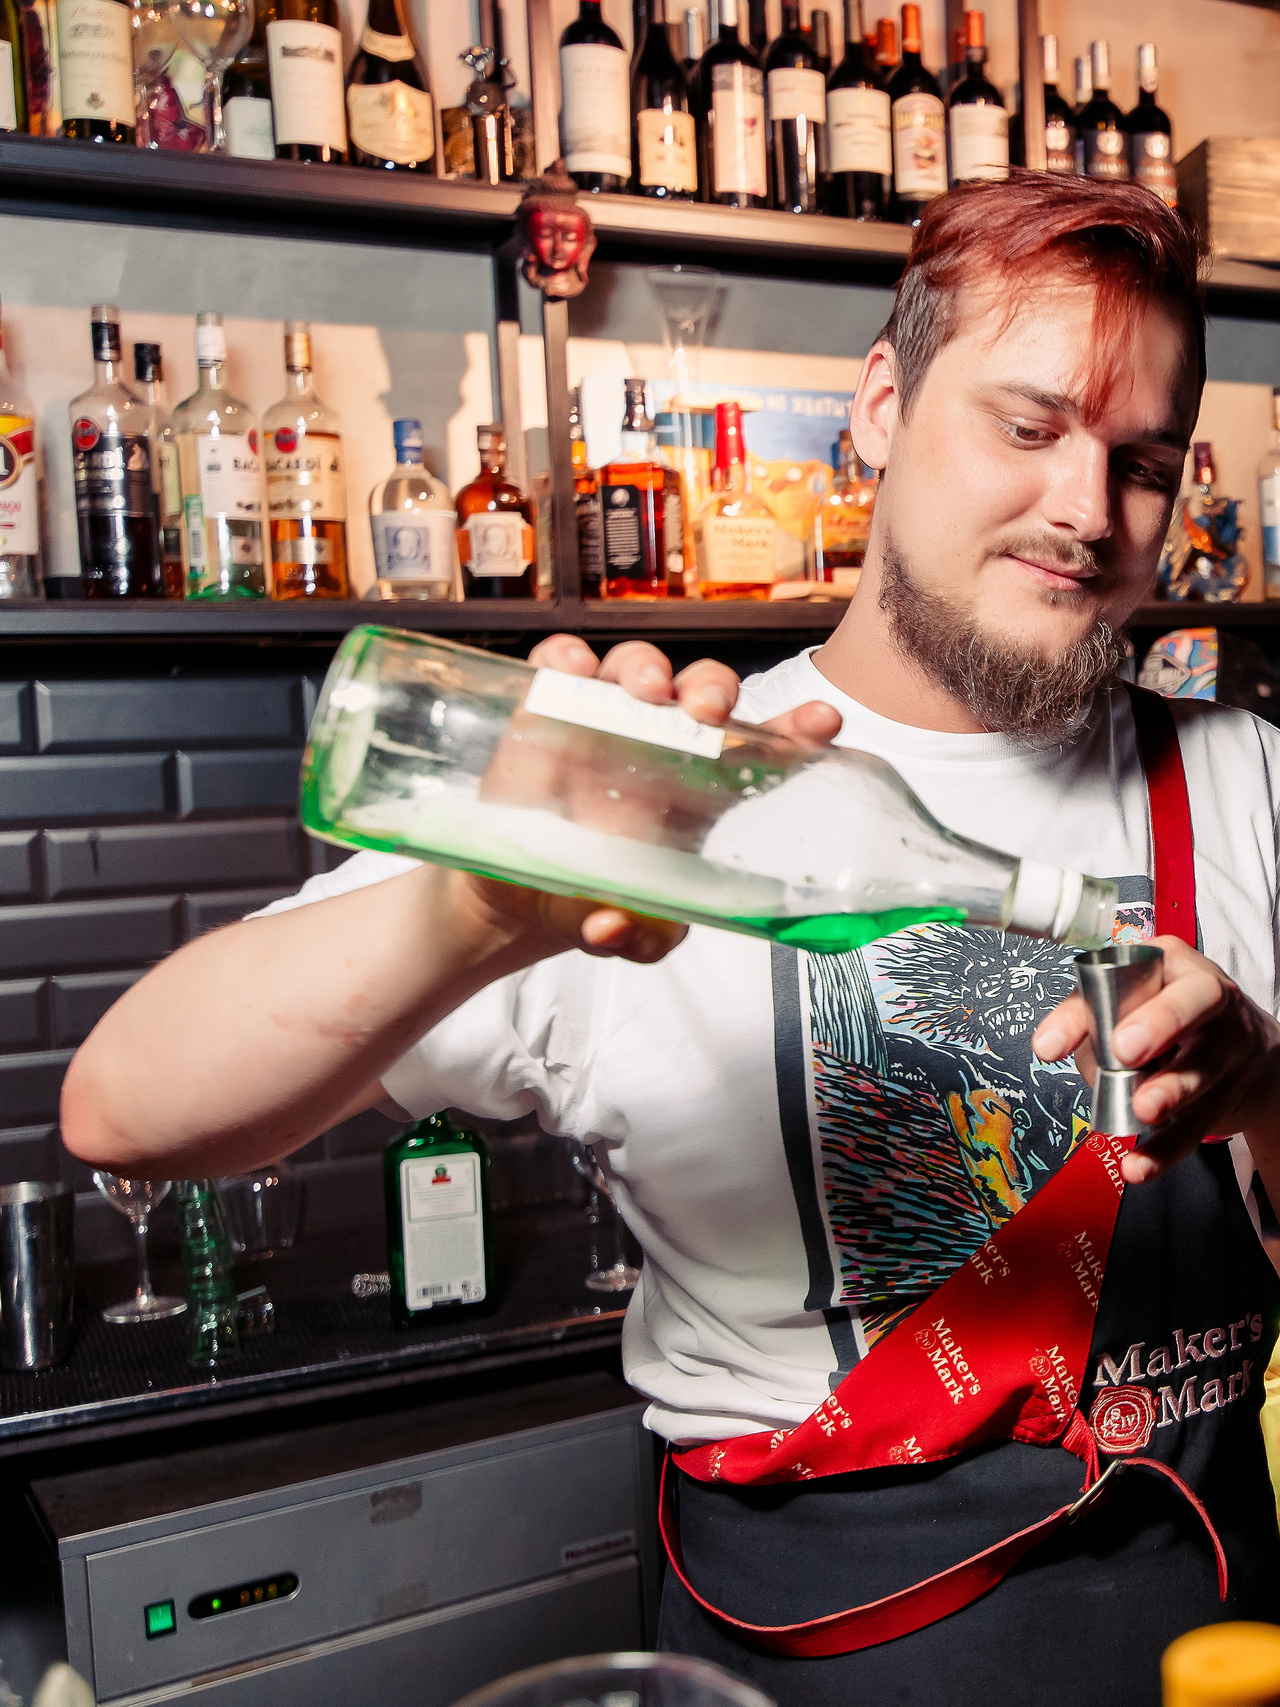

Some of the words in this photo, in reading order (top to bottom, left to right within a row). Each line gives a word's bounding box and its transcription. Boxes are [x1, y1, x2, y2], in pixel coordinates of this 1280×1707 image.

[970, 1253, 994, 1285] ark
[927, 1347, 965, 1405] Mark
[931, 1316, 982, 1396] Maker's
[1092, 1312, 1263, 1386] Maker's
[1157, 1358, 1254, 1428] Mark
